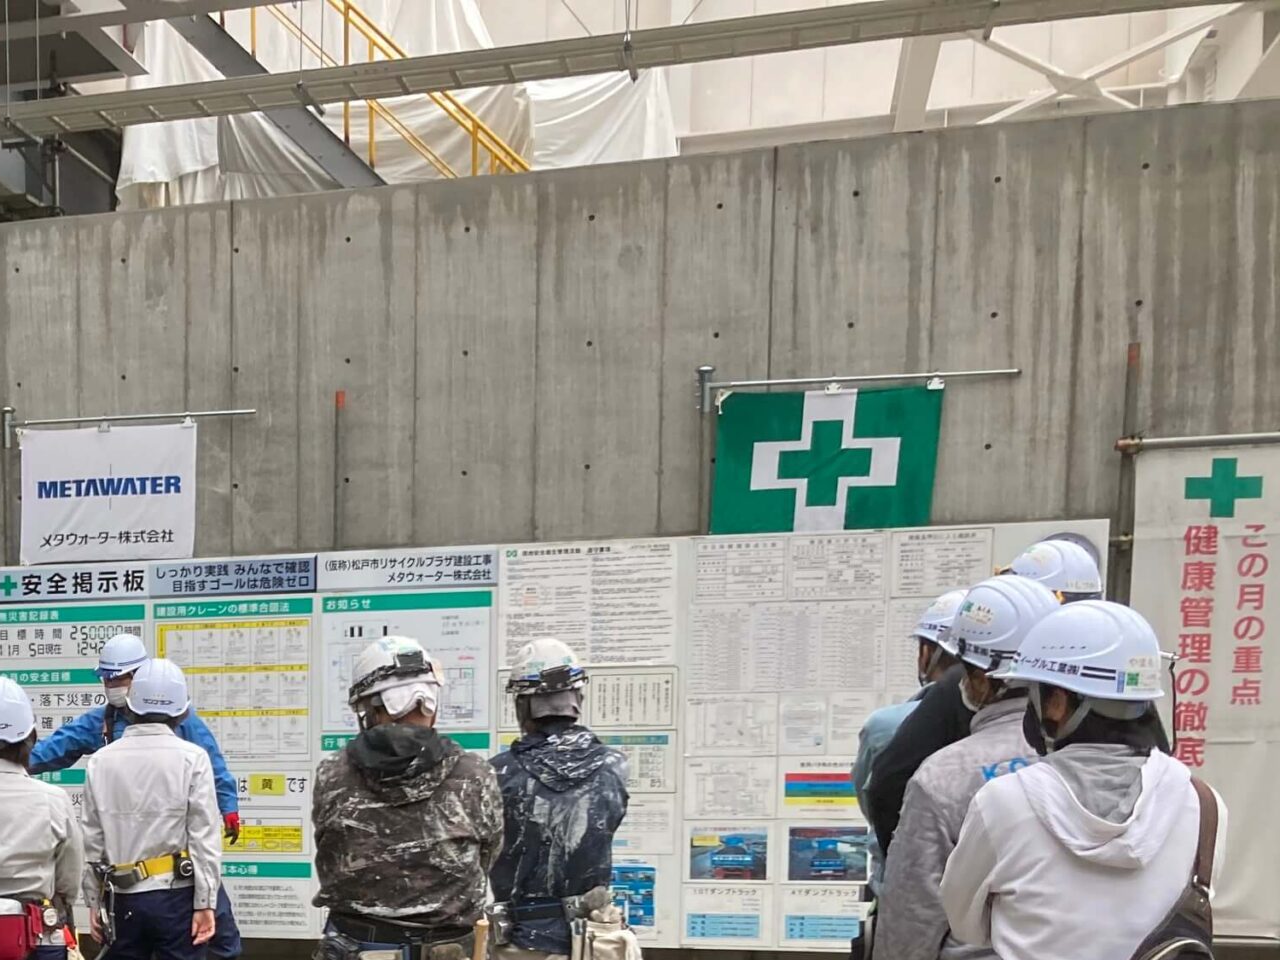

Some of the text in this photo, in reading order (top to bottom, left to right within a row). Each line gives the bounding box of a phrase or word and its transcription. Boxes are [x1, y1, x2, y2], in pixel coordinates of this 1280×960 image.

[38, 475, 181, 499] METAWATER
[40, 528, 174, 548] メタウォーター株式会社
[156, 560, 310, 579] しっかり実践 みんなで確認
[388, 569, 491, 583] メタウォーター株式会社
[22, 569, 145, 596] 安全掲示板
[173, 576, 309, 593] 目指すゴールは危険ゼロ
[326, 599, 371, 610] お知らせ
[1231, 523, 1269, 706] この月の重点
[1176, 525, 1219, 768] 健康管理の徹底
[286, 777, 308, 793] です
